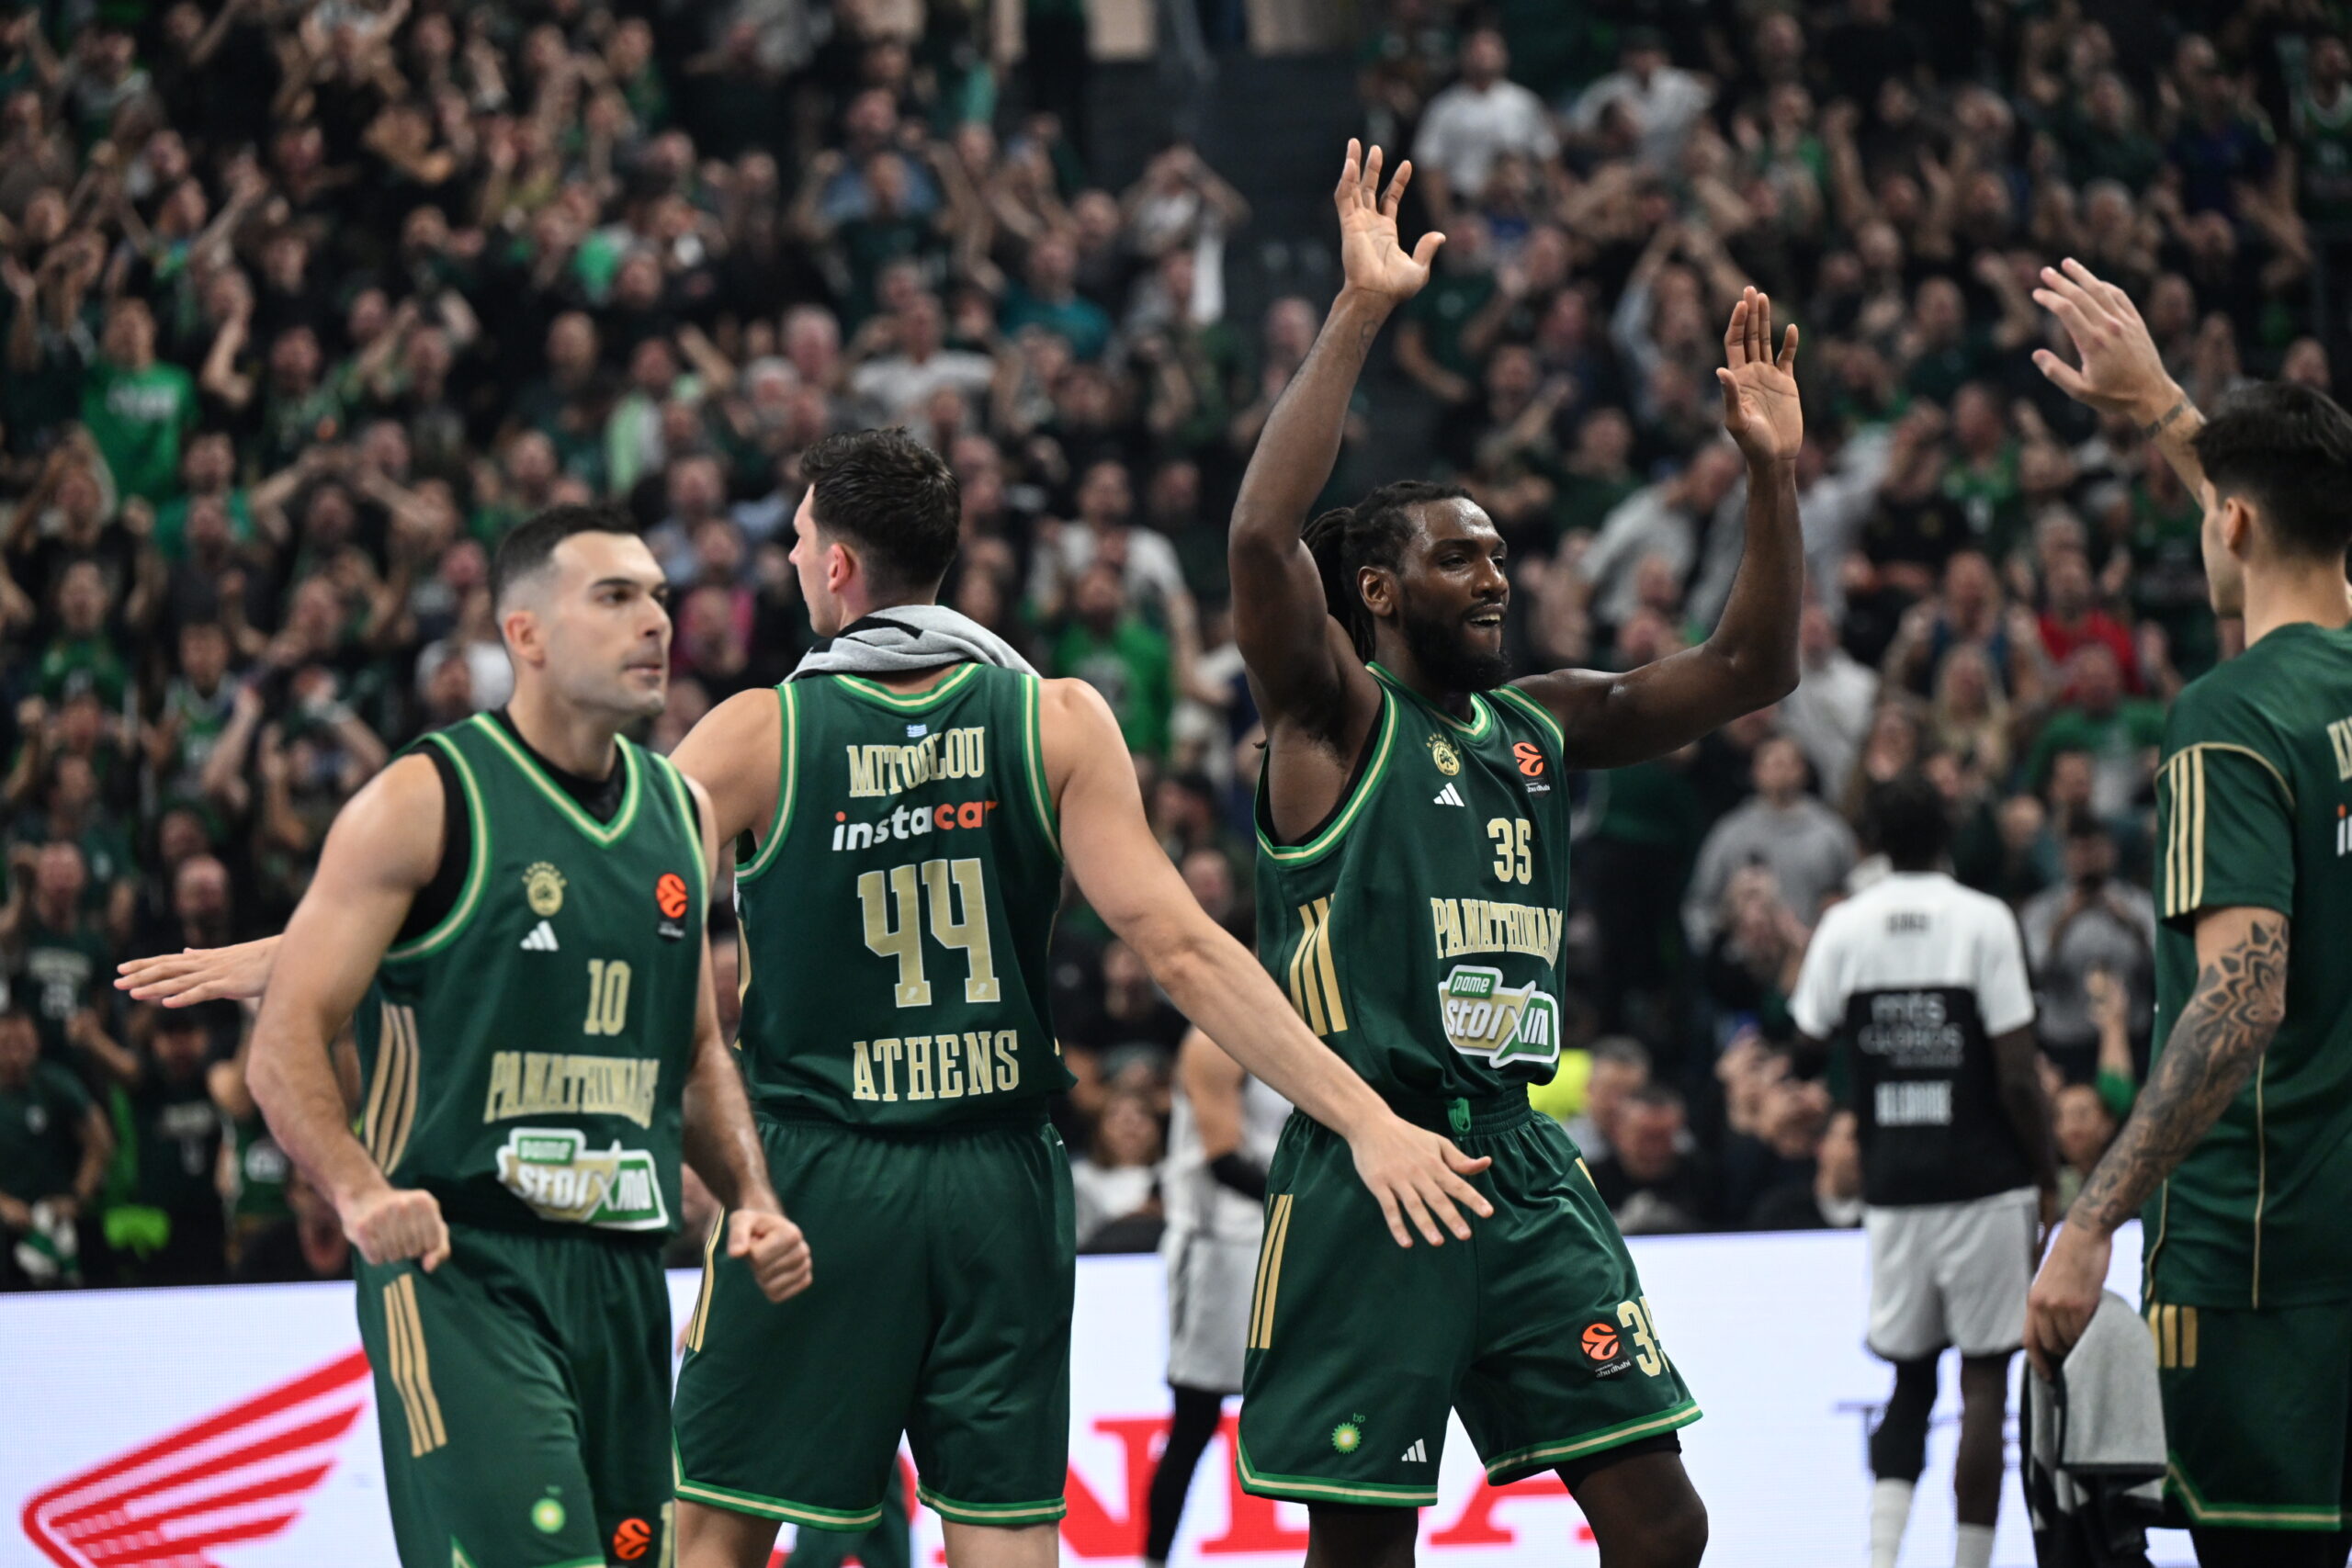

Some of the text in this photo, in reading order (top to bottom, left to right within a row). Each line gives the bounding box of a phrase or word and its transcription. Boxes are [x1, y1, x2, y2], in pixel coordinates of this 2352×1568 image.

[1487, 818, 1532, 885] 35
[857, 857, 1001, 1008] 44
[583, 958, 631, 1036] 10
[1452, 975, 1490, 993] pame
[853, 1030, 1020, 1101] ATHENS
[1611, 1359, 1632, 1374] dhabi
[1352, 1412, 1366, 1424] bp
